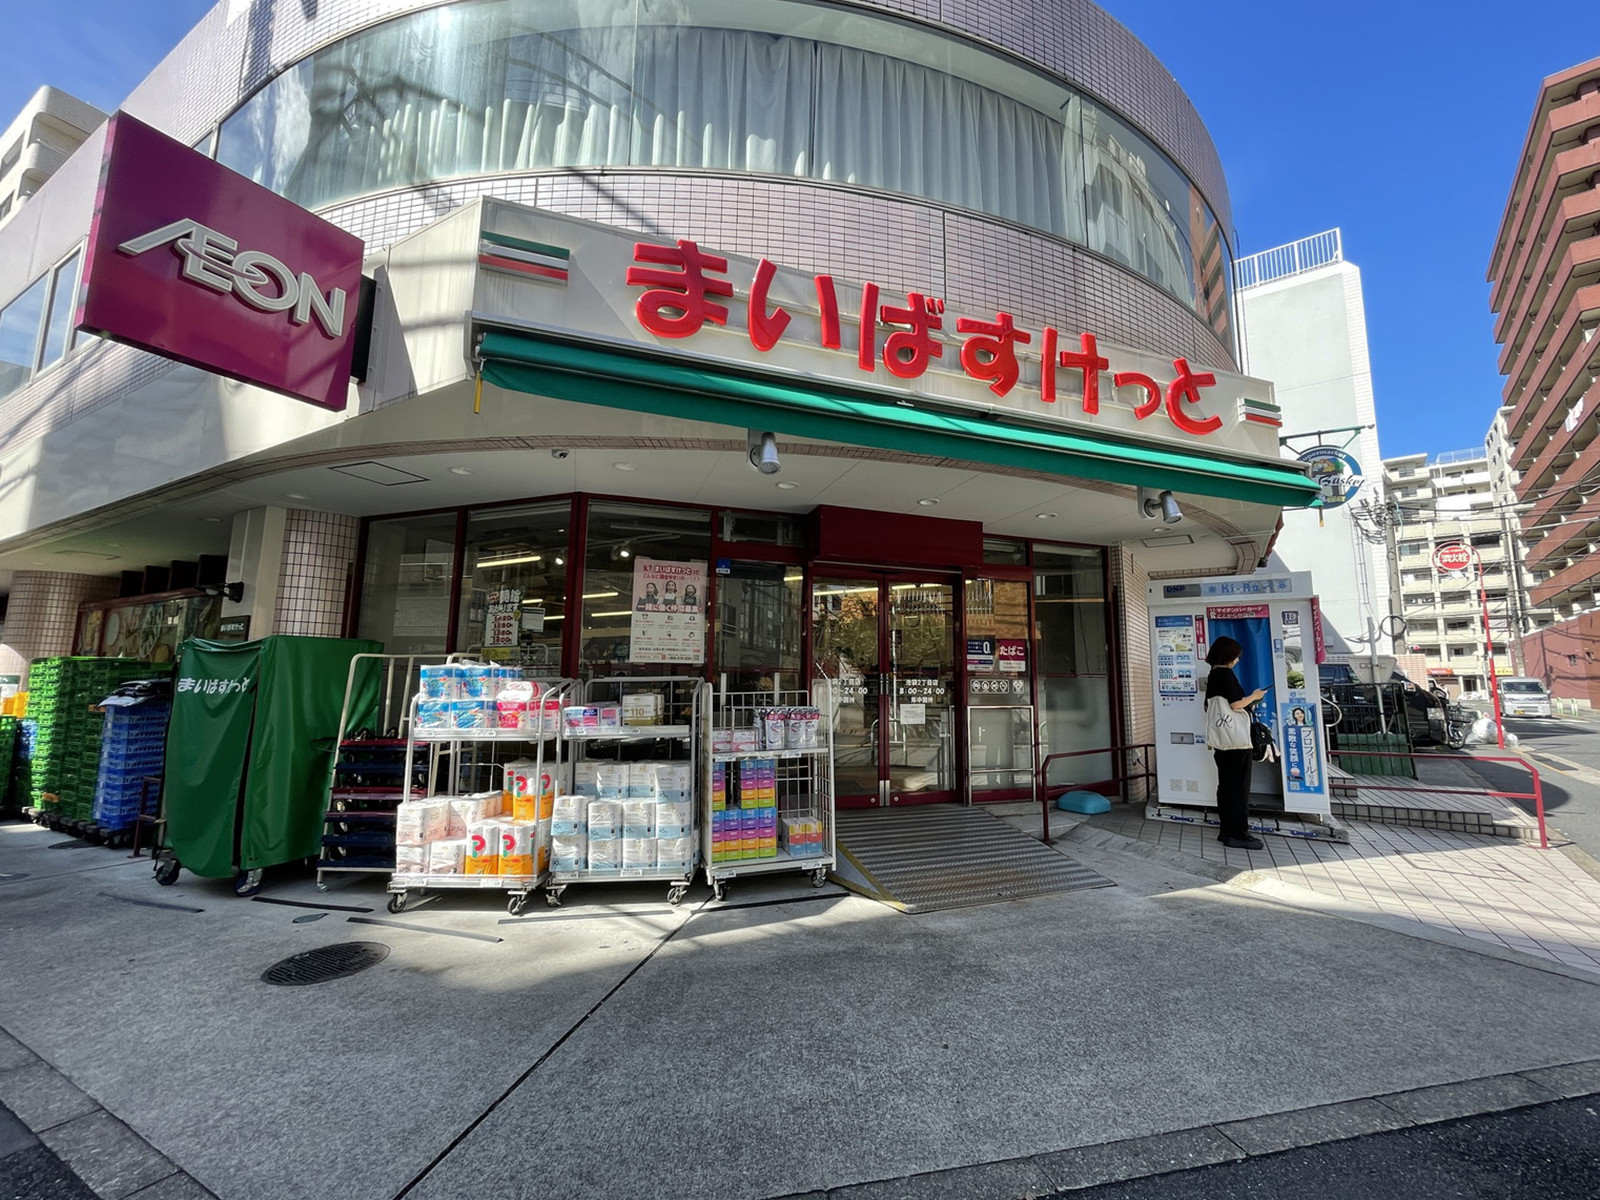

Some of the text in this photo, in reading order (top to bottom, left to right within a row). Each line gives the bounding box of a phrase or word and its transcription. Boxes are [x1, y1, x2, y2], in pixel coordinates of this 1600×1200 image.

[118, 217, 347, 337] AEON
[626, 239, 1223, 435] まいばすけっと
[1299, 449, 1347, 463] upermarket
[999, 645, 1025, 656] たばこ
